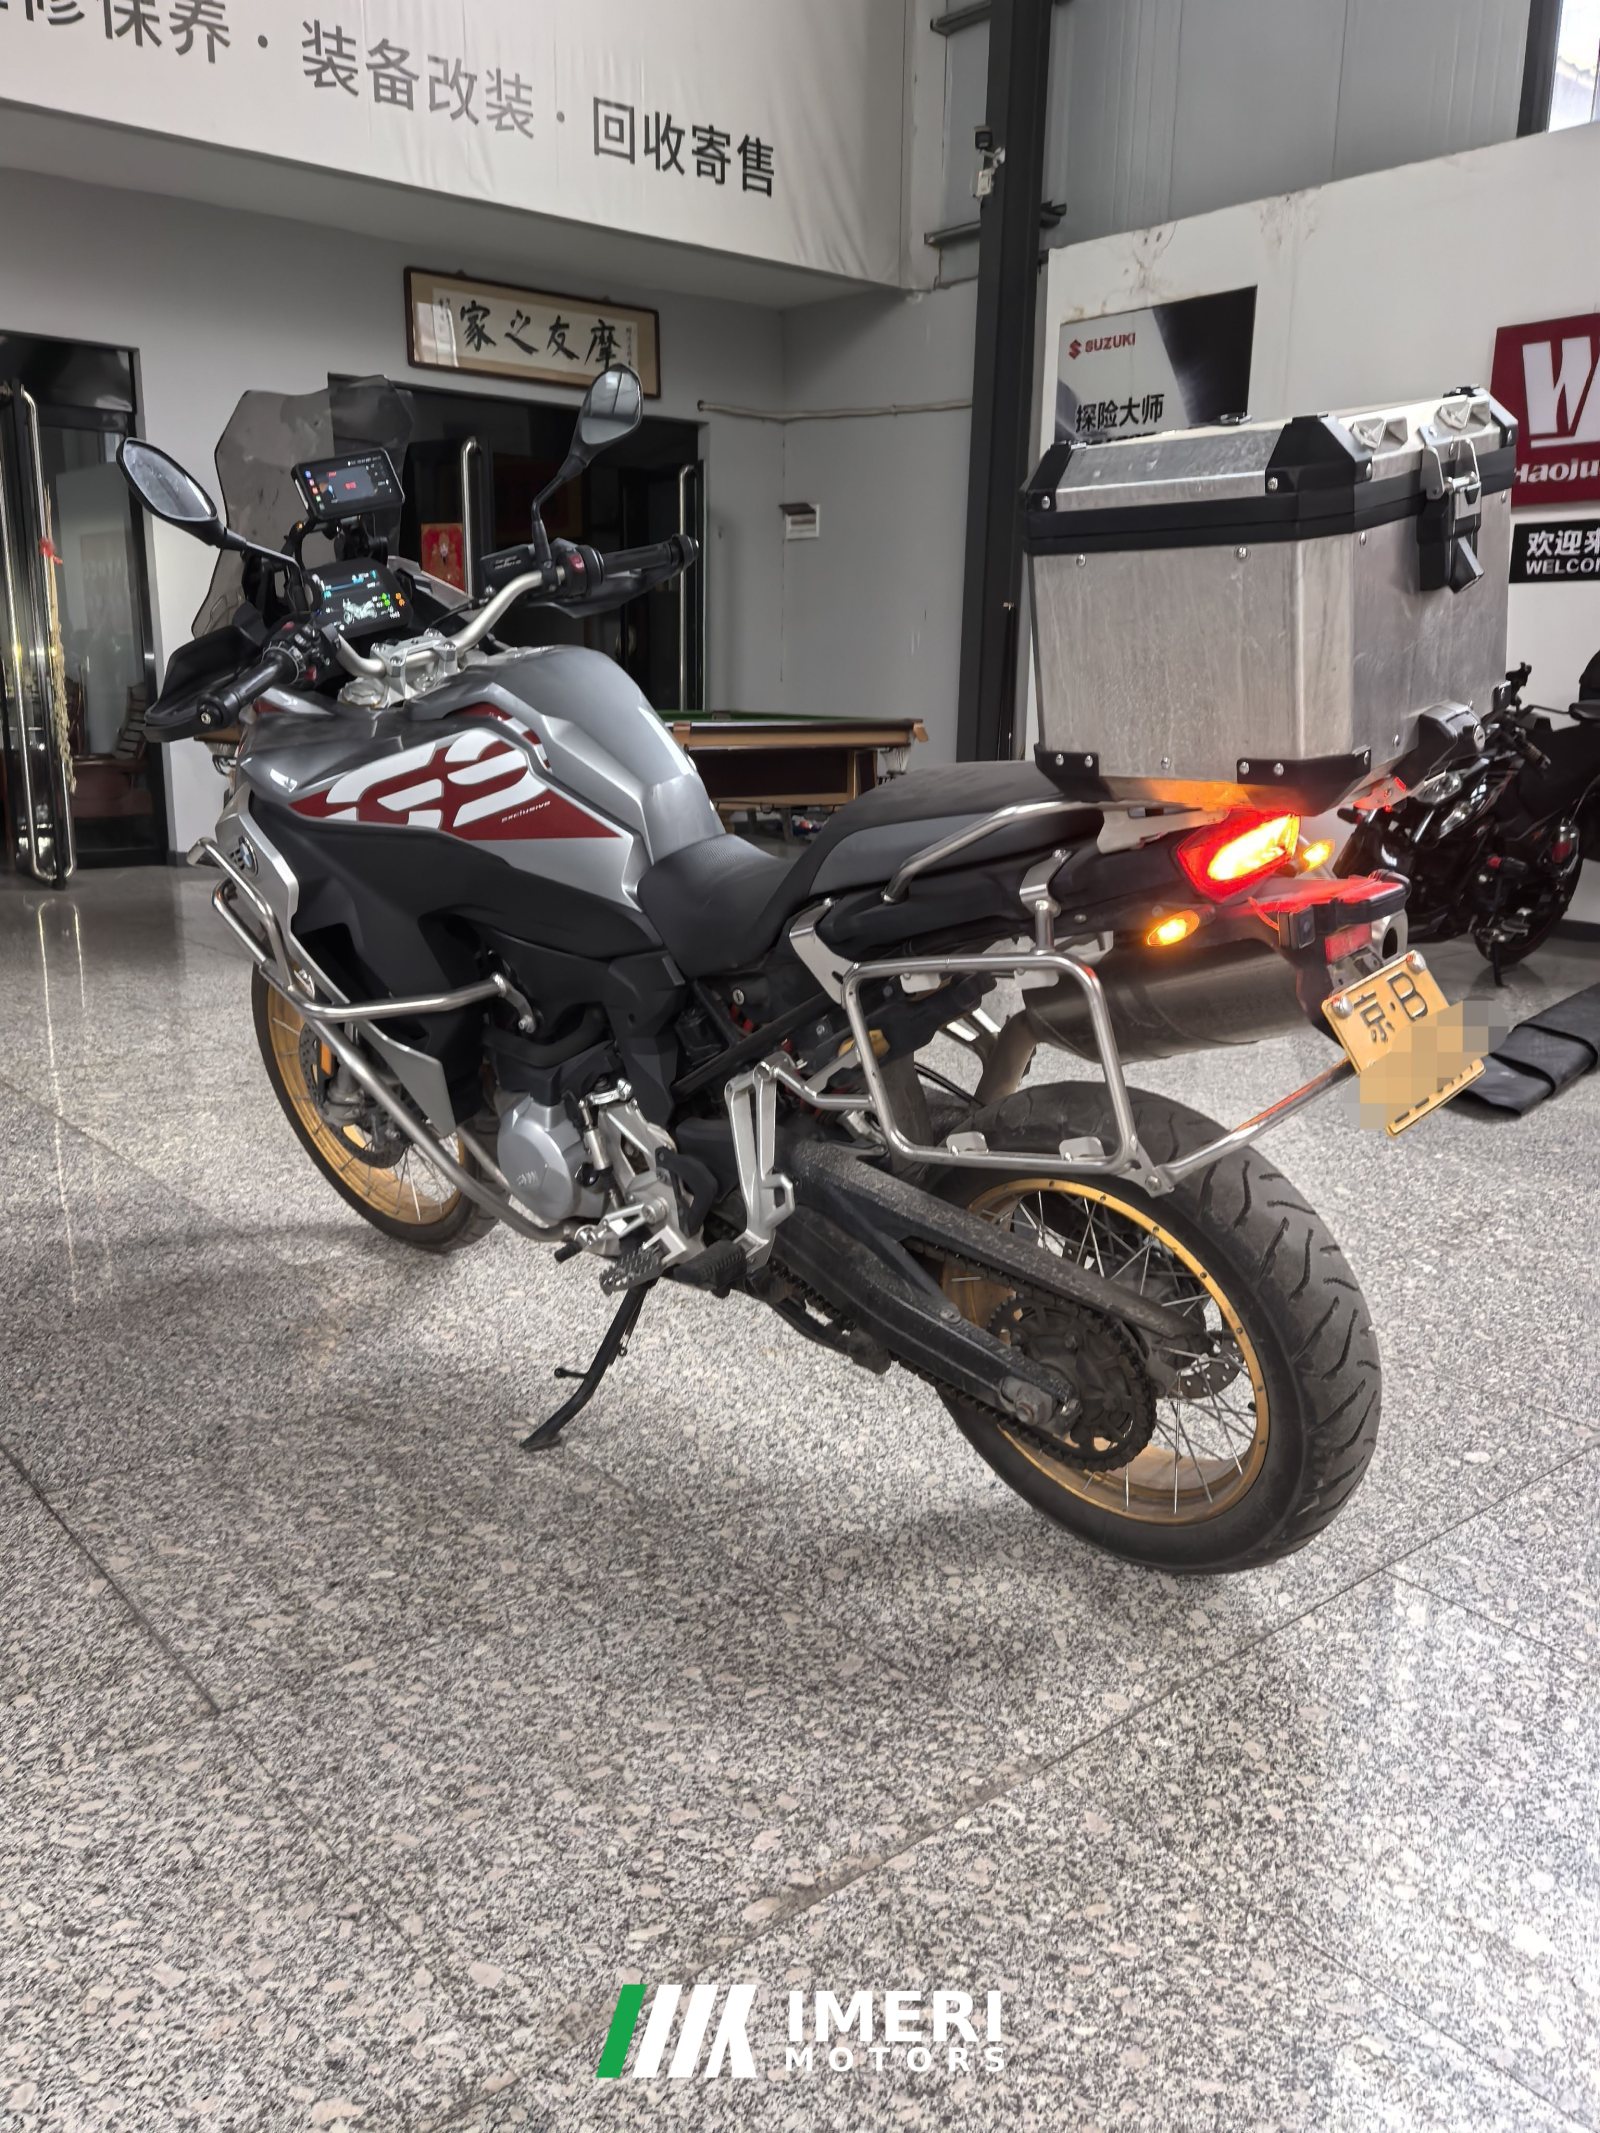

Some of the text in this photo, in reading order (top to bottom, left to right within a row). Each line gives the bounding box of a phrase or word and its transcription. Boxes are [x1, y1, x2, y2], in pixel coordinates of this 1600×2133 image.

[0, 0, 775, 198] 保养 装备改装 回收寄售
[1085, 332, 1136, 353] SUZUKI
[1075, 394, 1165, 433] 探险大师
[1514, 458, 1600, 484] Haoju
[1526, 557, 1600, 575] WELCO
